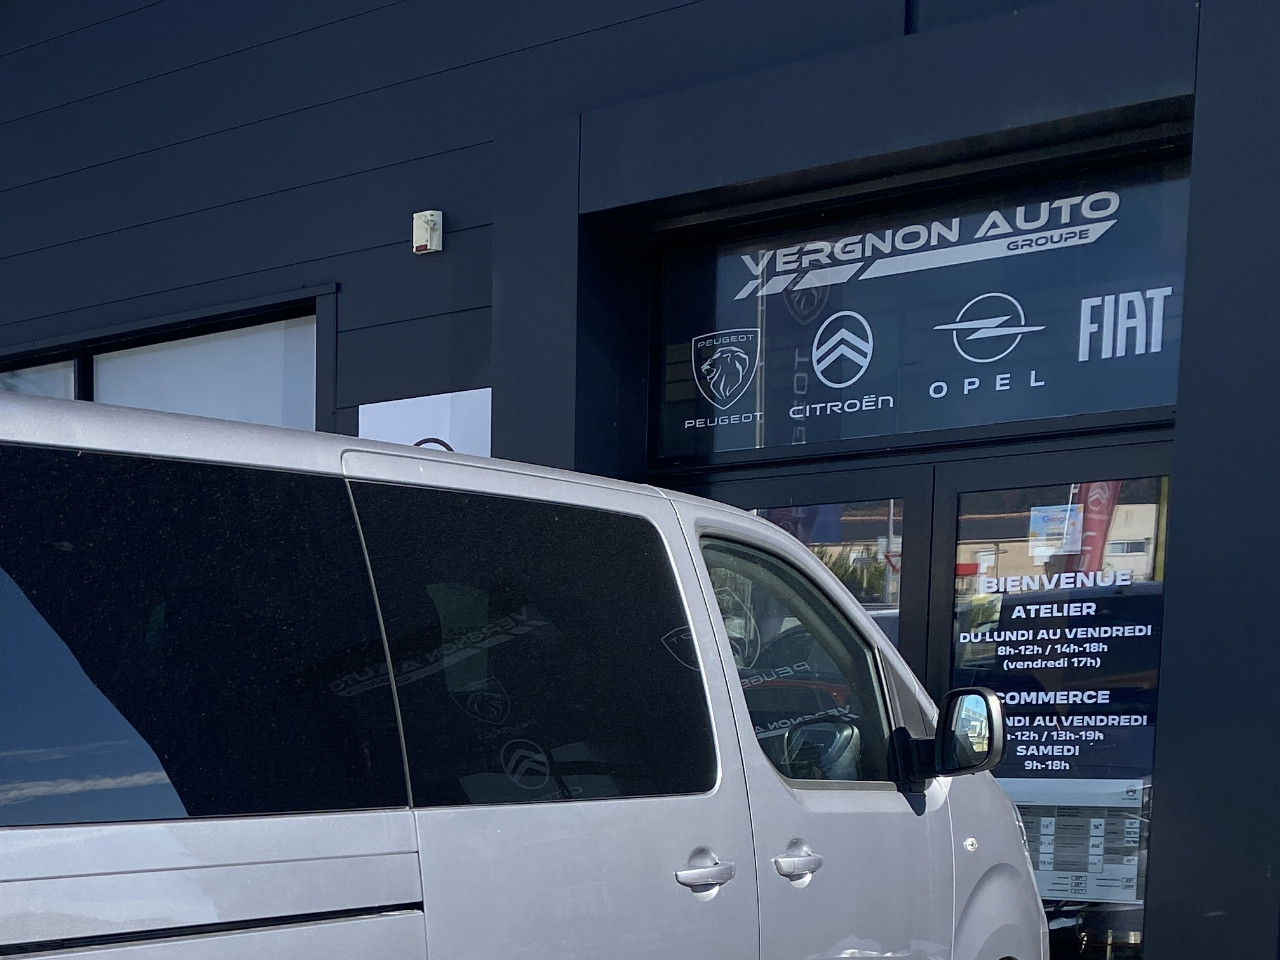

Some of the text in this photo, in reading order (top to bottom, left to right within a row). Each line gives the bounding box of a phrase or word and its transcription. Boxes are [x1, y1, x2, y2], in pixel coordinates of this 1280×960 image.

[741, 191, 1120, 276] VERGNON AUTO
[1006, 228, 1091, 251] GROUPE
[1078, 286, 1173, 362] FIAT
[697, 334, 755, 349] PEUGEOT
[928, 370, 1046, 399] OPEL
[684, 412, 764, 429] PEUGEOT
[982, 569, 1132, 593] BIENVENUE
[1011, 602, 1097, 619] ATELIER
[959, 625, 1153, 643] DU LUNDI AU VENDREDI
[997, 645, 1043, 656] 8h-12h
[1054, 642, 1108, 654] 14h-18h
[1003, 656, 1101, 670] (vendredi 17h)
[1033, 716, 1058, 727] AU
[1061, 715, 1148, 726] VENDREDI
[1051, 730, 1104, 741] 13h-19h
[1016, 745, 1080, 756] SAMEDI
[1024, 760, 1070, 770] 9h-18h
